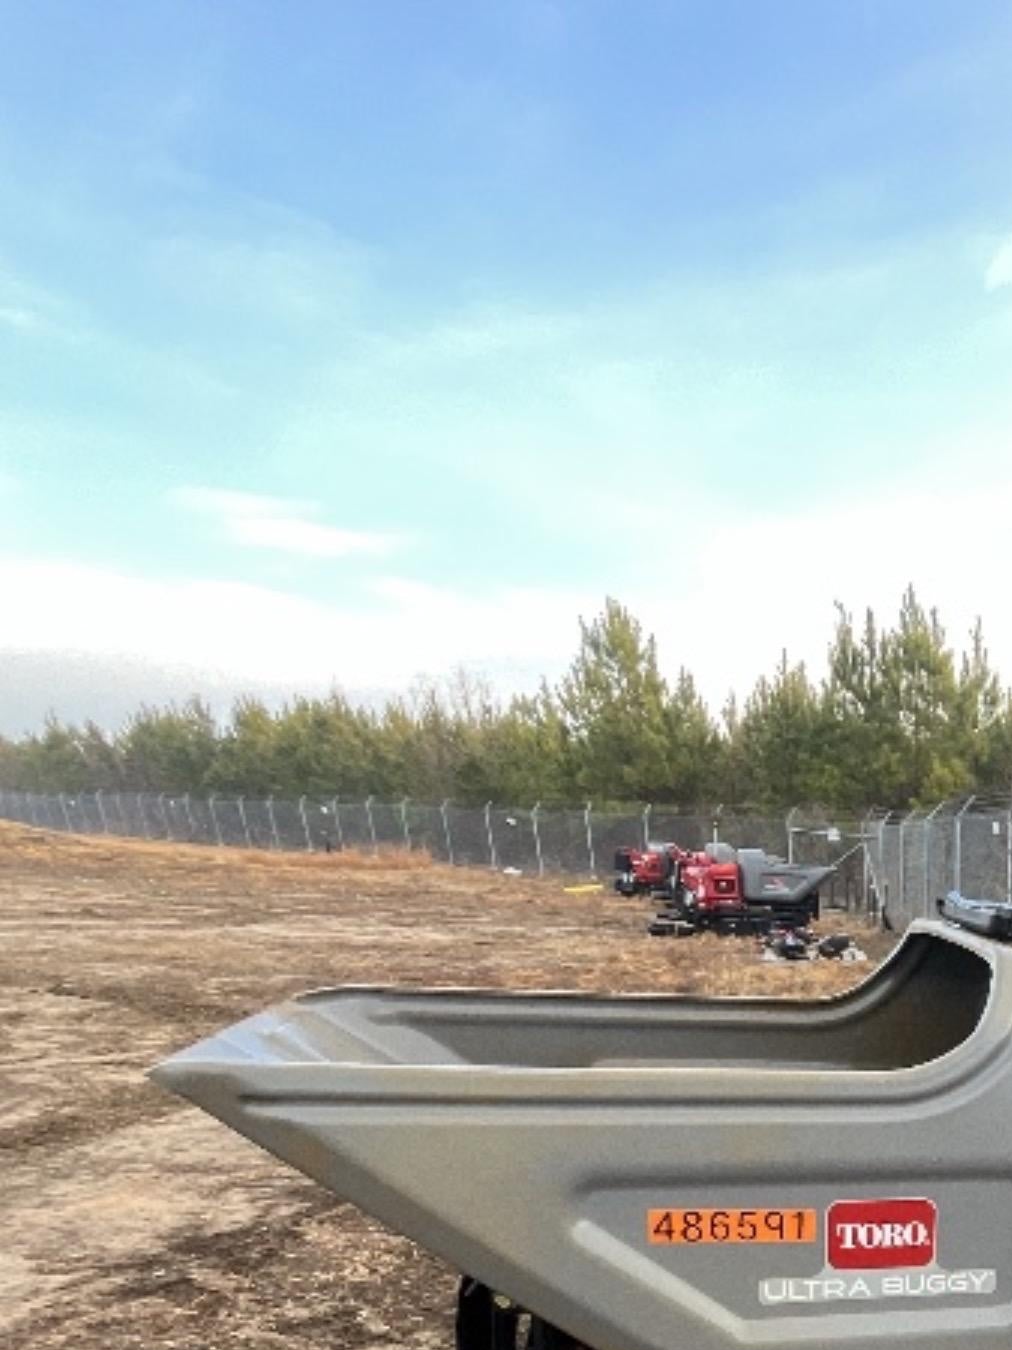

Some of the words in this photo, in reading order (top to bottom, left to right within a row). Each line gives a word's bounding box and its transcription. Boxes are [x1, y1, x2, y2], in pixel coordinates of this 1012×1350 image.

[652, 1211, 806, 1242] 486591
[763, 1279, 871, 1300] ULTRA
[881, 1273, 991, 1296] BUGGY
